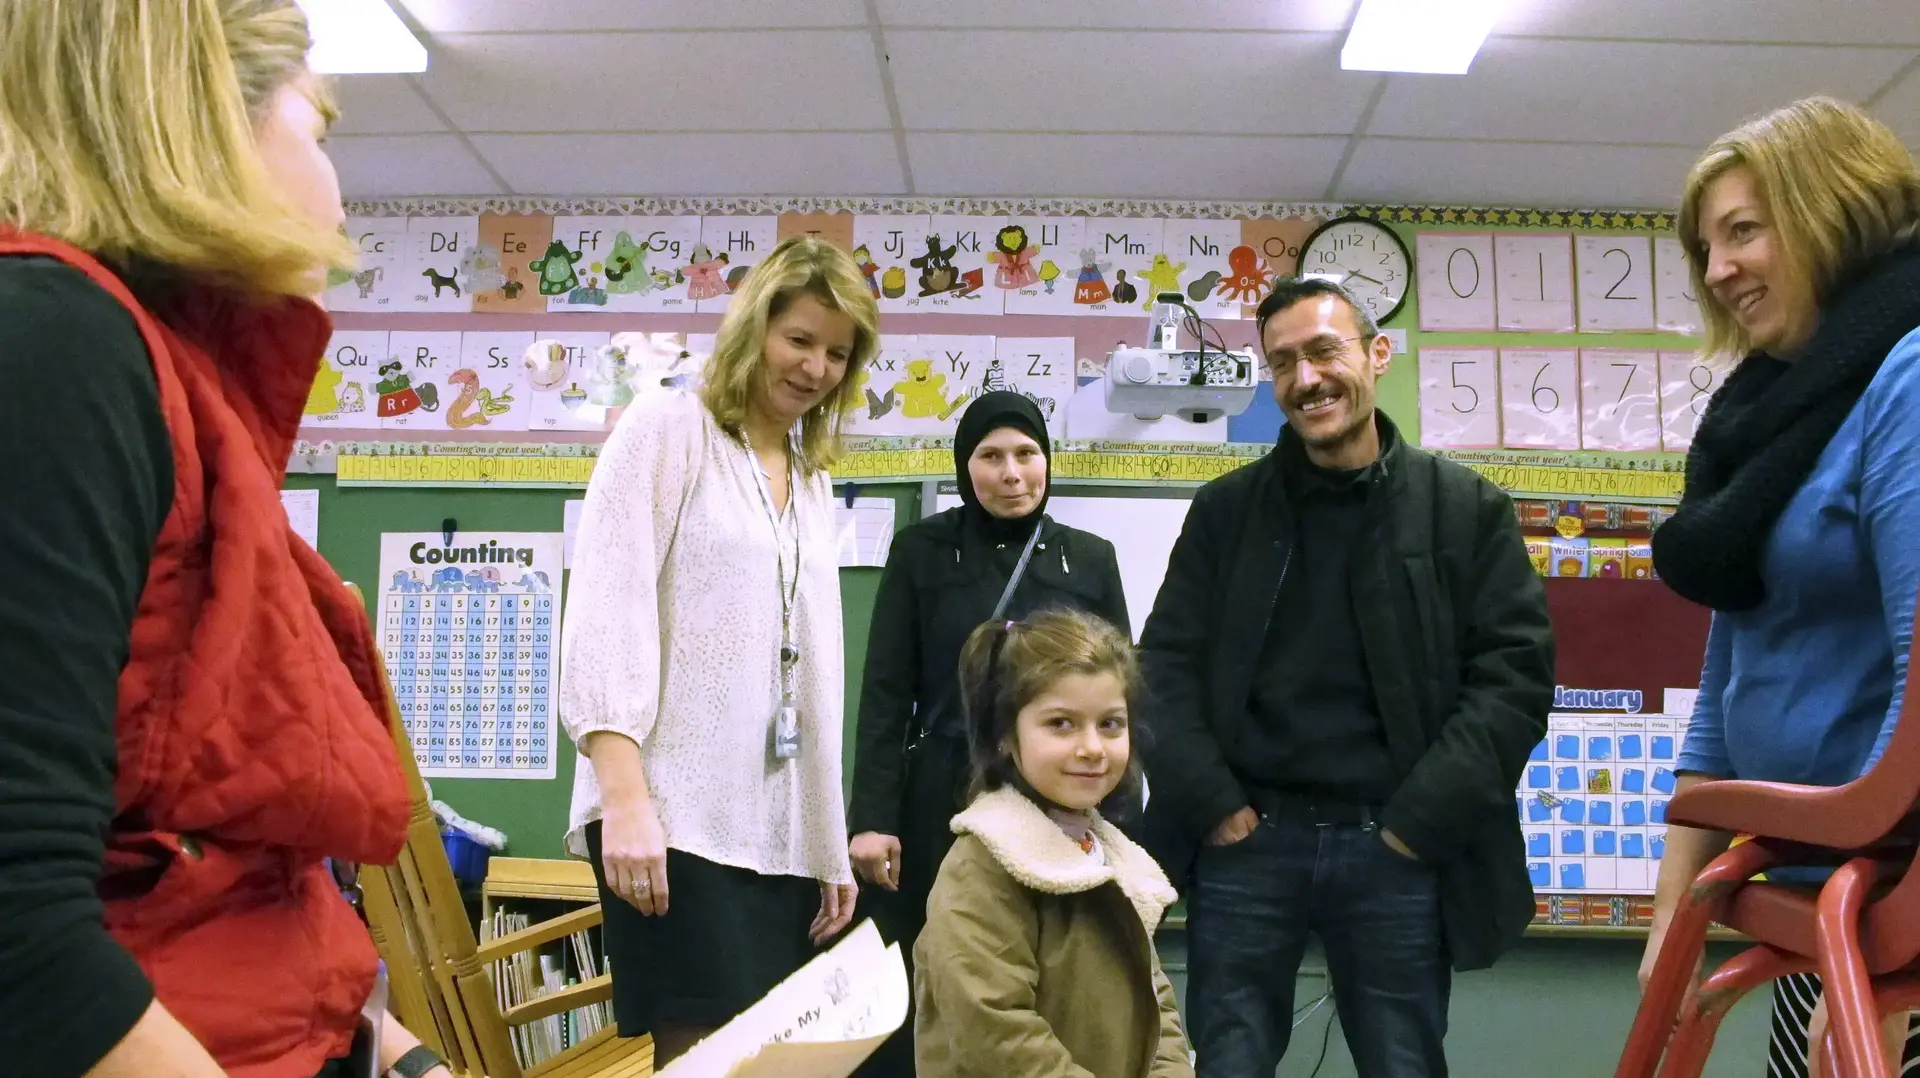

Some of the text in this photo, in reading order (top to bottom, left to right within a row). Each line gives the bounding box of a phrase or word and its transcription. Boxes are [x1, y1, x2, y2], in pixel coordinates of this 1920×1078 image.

[359, 233, 384, 252] Cc
[431, 232, 458, 253] Dd
[503, 233, 527, 253] Ee
[579, 231, 602, 251] Ff
[648, 231, 680, 259] Gg
[729, 231, 754, 251] Hh
[884, 231, 904, 259] Jj
[956, 231, 980, 252] Kk
[1042, 225, 1058, 246] Ll
[1105, 233, 1145, 255] Mm
[1190, 235, 1219, 256] Nn
[1333, 239, 1344, 251] 11
[1348, 234, 1363, 247] 12
[1263, 237, 1299, 258] Oo
[1319, 251, 1336, 264] 10
[1379, 252, 1389, 265] 2
[1384, 269, 1394, 282] 3
[1447, 248, 1479, 298] 0
[1539, 252, 1544, 301] 1
[1603, 248, 1637, 300] 2
[415, 294, 428, 302] dog
[663, 298, 683, 306] game
[1019, 288, 1038, 296] lamp
[1380, 286, 1390, 298] 4
[1367, 297, 1377, 310] 5
[336, 346, 367, 366] Qu
[416, 347, 438, 368] Rr
[488, 347, 509, 369] Ss
[565, 346, 586, 368] Tt
[945, 351, 970, 380] Yy
[1027, 354, 1052, 376] Zz
[1451, 361, 1478, 414] 5
[1532, 362, 1559, 414] 6
[1610, 364, 1637, 415] 7
[1689, 365, 1713, 415] 8
[317, 414, 339, 422] queen
[434, 444, 473, 456] Counting
[496, 446, 519, 456] great
[521, 447, 543, 456] year!
[1102, 441, 1145, 453] Counting
[1169, 443, 1194, 454] great
[1197, 444, 1220, 455] year!
[1448, 450, 1492, 463] Counting
[1516, 454, 1540, 464] great
[1542, 455, 1566, 464] year!
[449, 459, 460, 478] 8
[1535, 470, 1549, 486] 72
[1552, 472, 1567, 489] 73
[1602, 472, 1616, 490] 76
[409, 540, 534, 568] Counting
[1592, 545, 1624, 559] Spring
[394, 600, 397, 608] 1
[409, 600, 415, 608] 2
[425, 600, 430, 608] 3
[457, 600, 463, 608] 5
[473, 600, 480, 608] 6
[490, 600, 496, 608] 7
[507, 600, 512, 608] 8
[538, 600, 550, 608] 10
[390, 617, 549, 625] 11 12 13 14 15 16 17 18 19 20
[388, 634, 548, 643] 21 22 23 24 25 26 27 28 29 30
[387, 651, 548, 660] 31 32 33 34 35 36 37 38 39 40
[401, 668, 414, 676] 42
[417, 669, 431, 677] 43
[450, 668, 463, 677] 45
[467, 669, 480, 677] 46
[484, 669, 496, 677] 47
[501, 669, 514, 677] 48
[518, 669, 531, 677] 49
[534, 669, 547, 677] 50
[401, 685, 547, 694] 52 53 54 55 56 57 58 59 60
[1553, 686, 1642, 713] January
[416, 755, 547, 764] 93 94 95 96 97 98 99 100
[797, 1006, 821, 1028] My
